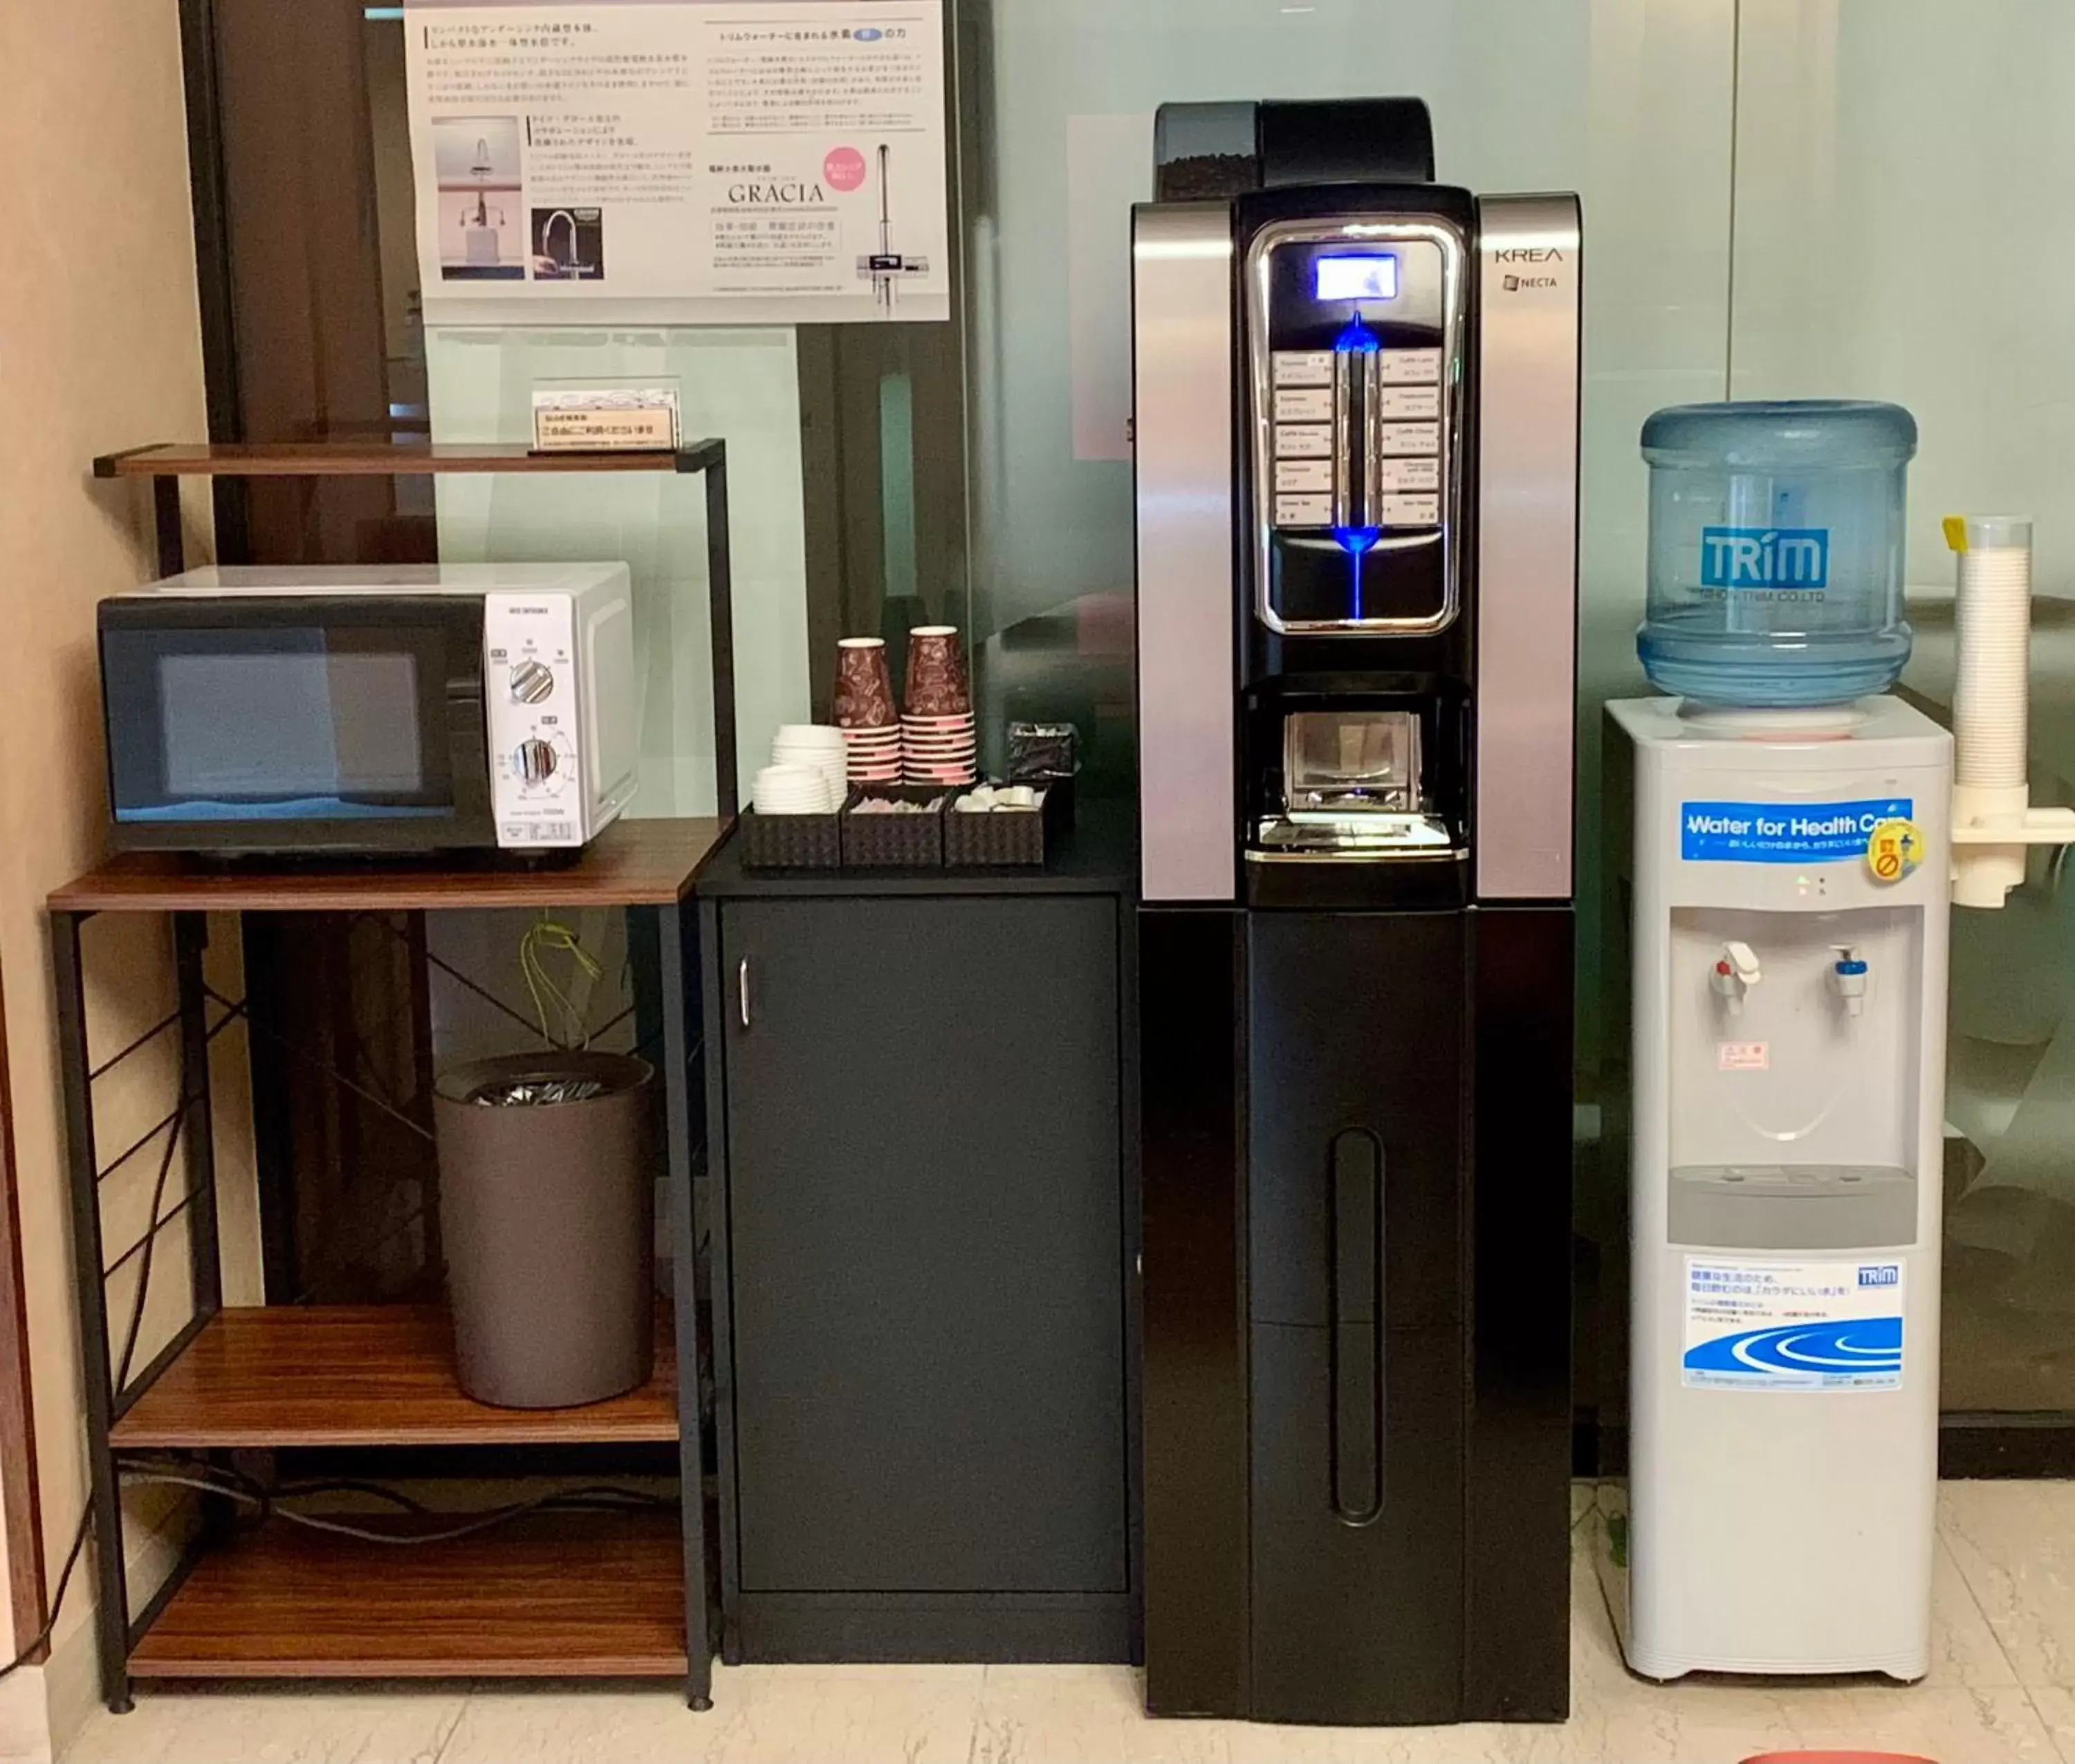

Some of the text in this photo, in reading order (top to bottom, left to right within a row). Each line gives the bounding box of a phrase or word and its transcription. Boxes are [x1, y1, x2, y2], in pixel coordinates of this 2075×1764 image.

[728, 183, 824, 203] GRACIA
[1495, 248, 1564, 263] KREA
[1521, 277, 1558, 288] NECTA
[1688, 815, 1749, 834] Water
[1756, 818, 1786, 836] for
[1791, 816, 1856, 836] Health
